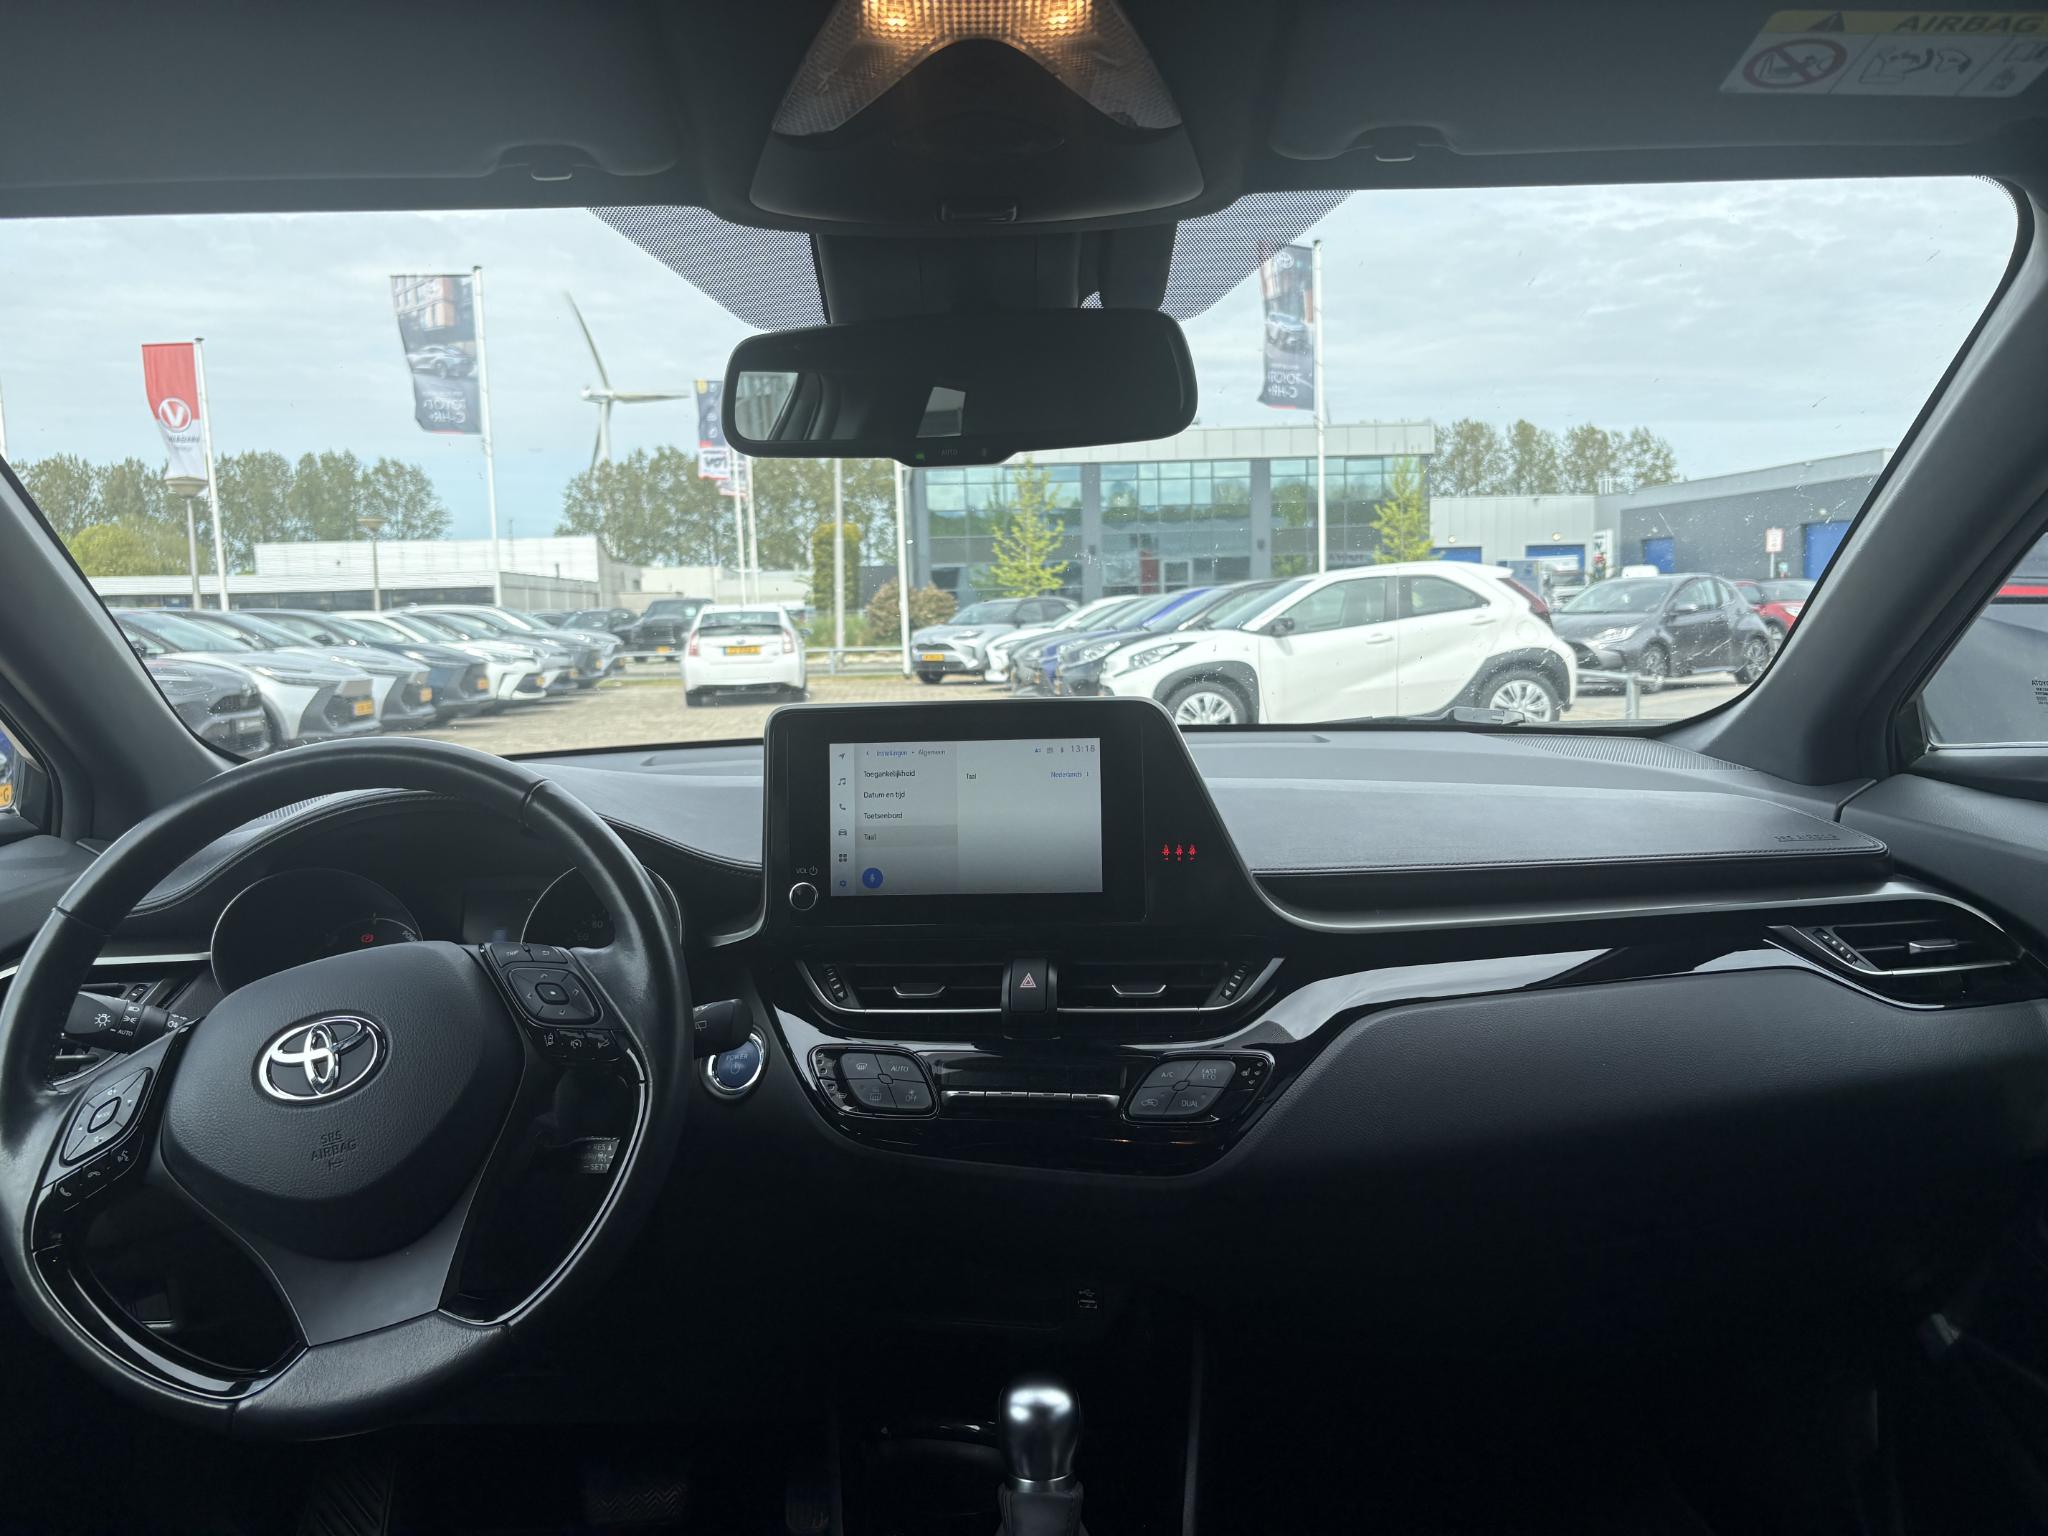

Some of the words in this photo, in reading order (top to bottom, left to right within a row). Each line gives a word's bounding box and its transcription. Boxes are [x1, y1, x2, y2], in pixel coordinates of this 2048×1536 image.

[1894, 15, 2043, 32] AIRBAG
[863, 791, 885, 799] Datum
[895, 791, 906, 800] tijd
[863, 833, 877, 841] Taal
[117, 1028, 134, 1037] AUTO
[725, 1052, 749, 1061] POWER
[890, 1063, 910, 1073] AUTO
[1201, 1067, 1218, 1075] FAST
[1160, 1071, 1174, 1079] A/C
[1181, 1099, 1198, 1107] DUAL
